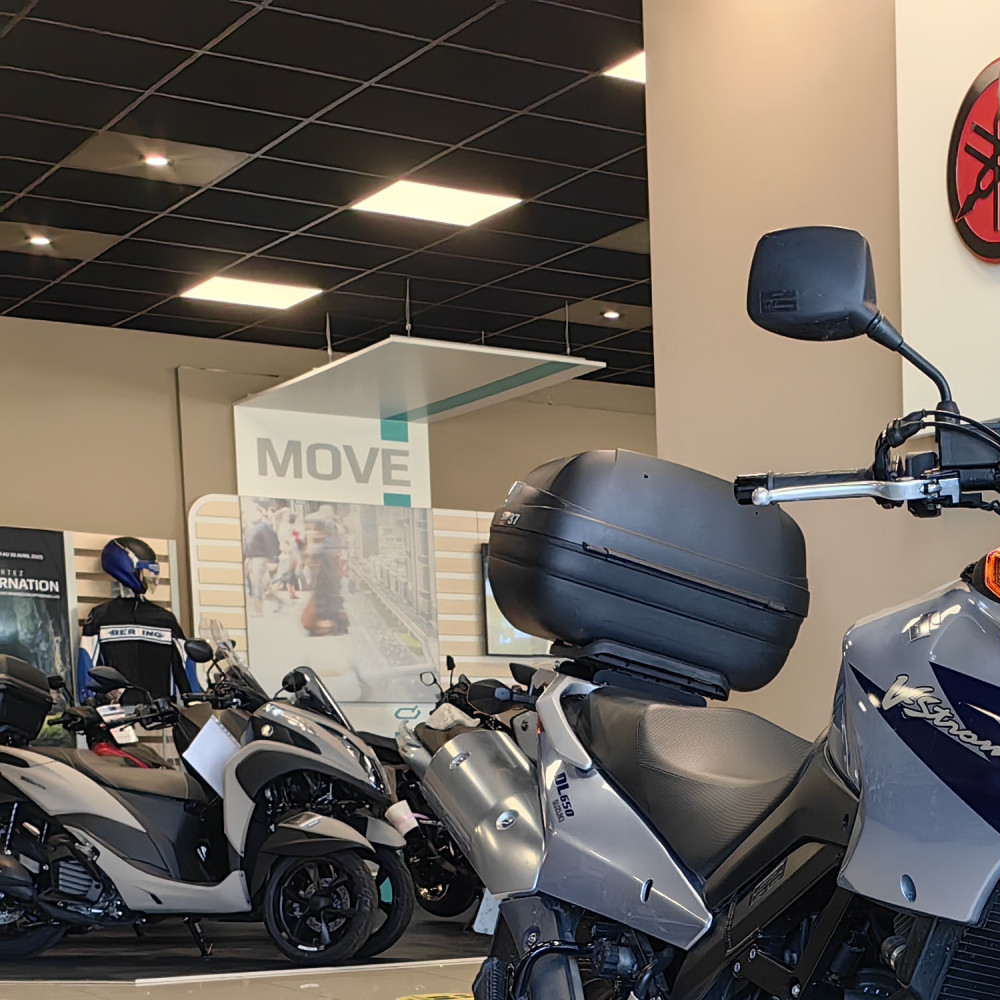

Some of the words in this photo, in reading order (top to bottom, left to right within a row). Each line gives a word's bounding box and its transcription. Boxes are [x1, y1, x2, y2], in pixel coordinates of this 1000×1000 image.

[256, 437, 411, 487] MOVE
[0, 577, 60, 593] RNATION
[555, 772, 575, 817] DL650
